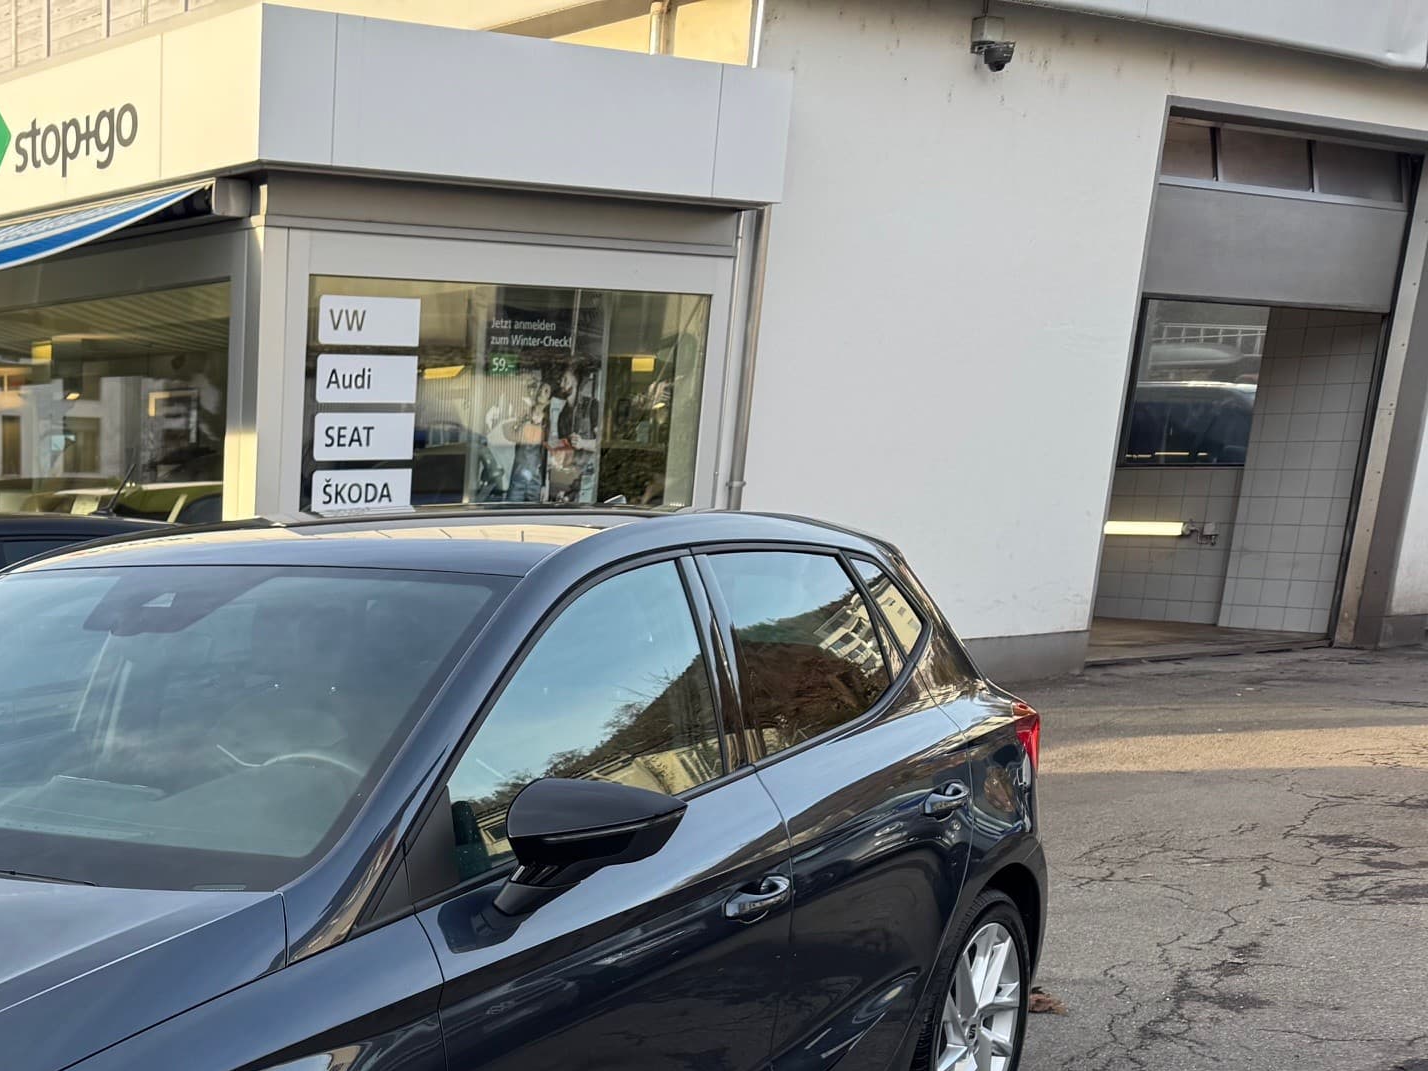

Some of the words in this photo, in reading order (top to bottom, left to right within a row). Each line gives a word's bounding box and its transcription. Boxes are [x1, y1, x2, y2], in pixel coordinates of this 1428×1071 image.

[15, 103, 138, 178] stop+go
[329, 308, 366, 332] VW
[491, 318, 512, 329] Jetzt
[514, 319, 556, 331] anmelden
[490, 335, 509, 345] zum
[510, 335, 572, 348] Winter-Check!
[326, 368, 373, 390] Audi
[324, 426, 375, 448] SEAT
[322, 478, 392, 505] ŠKODA
